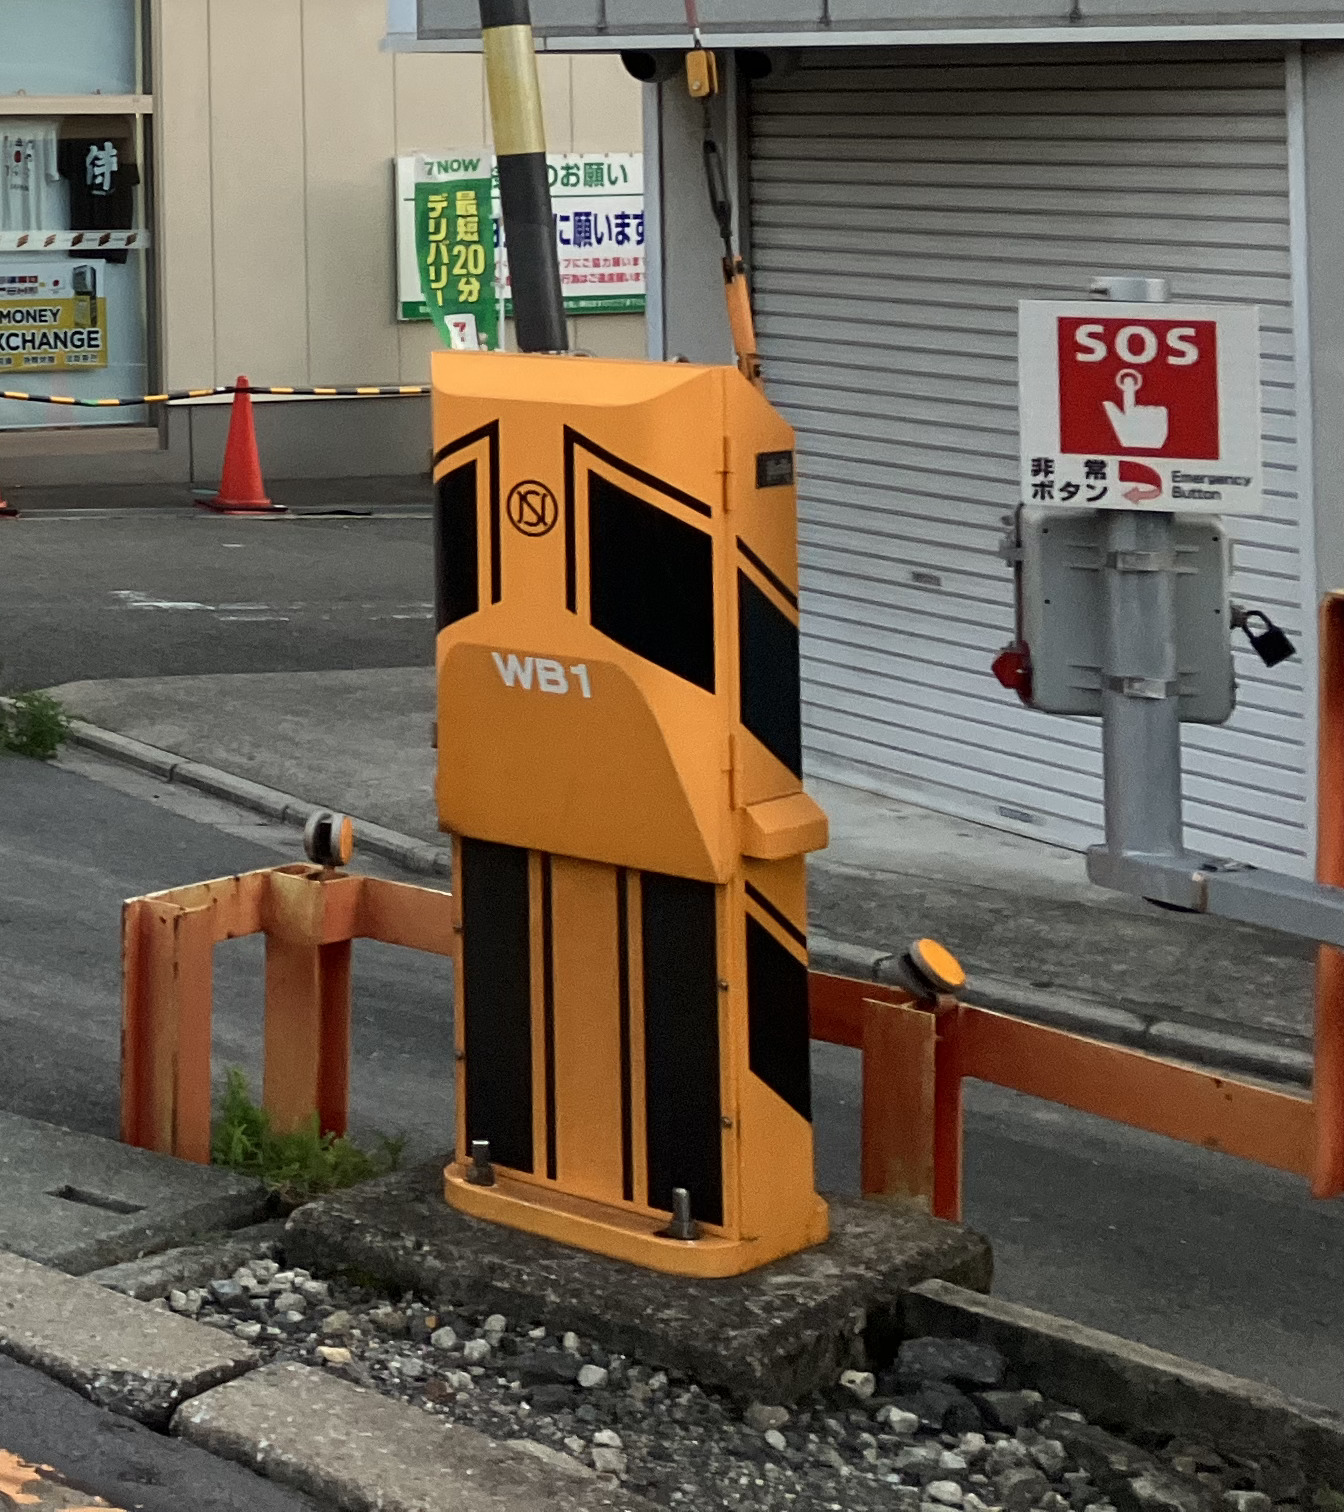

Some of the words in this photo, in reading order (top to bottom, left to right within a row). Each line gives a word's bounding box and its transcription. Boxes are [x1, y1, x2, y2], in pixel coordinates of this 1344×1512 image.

[86, 141, 118, 191] 侍
[424, 158, 481, 176] 7NOW
[426, 192, 450, 307] デリバリー
[452, 190, 486, 303] 最短20分
[1075, 324, 1200, 366] SOS
[1031, 480, 1108, 502] ボタン
[1171, 470, 1252, 486] Emergency
[1172, 486, 1222, 500] Button
[491, 651, 593, 699] WB1
